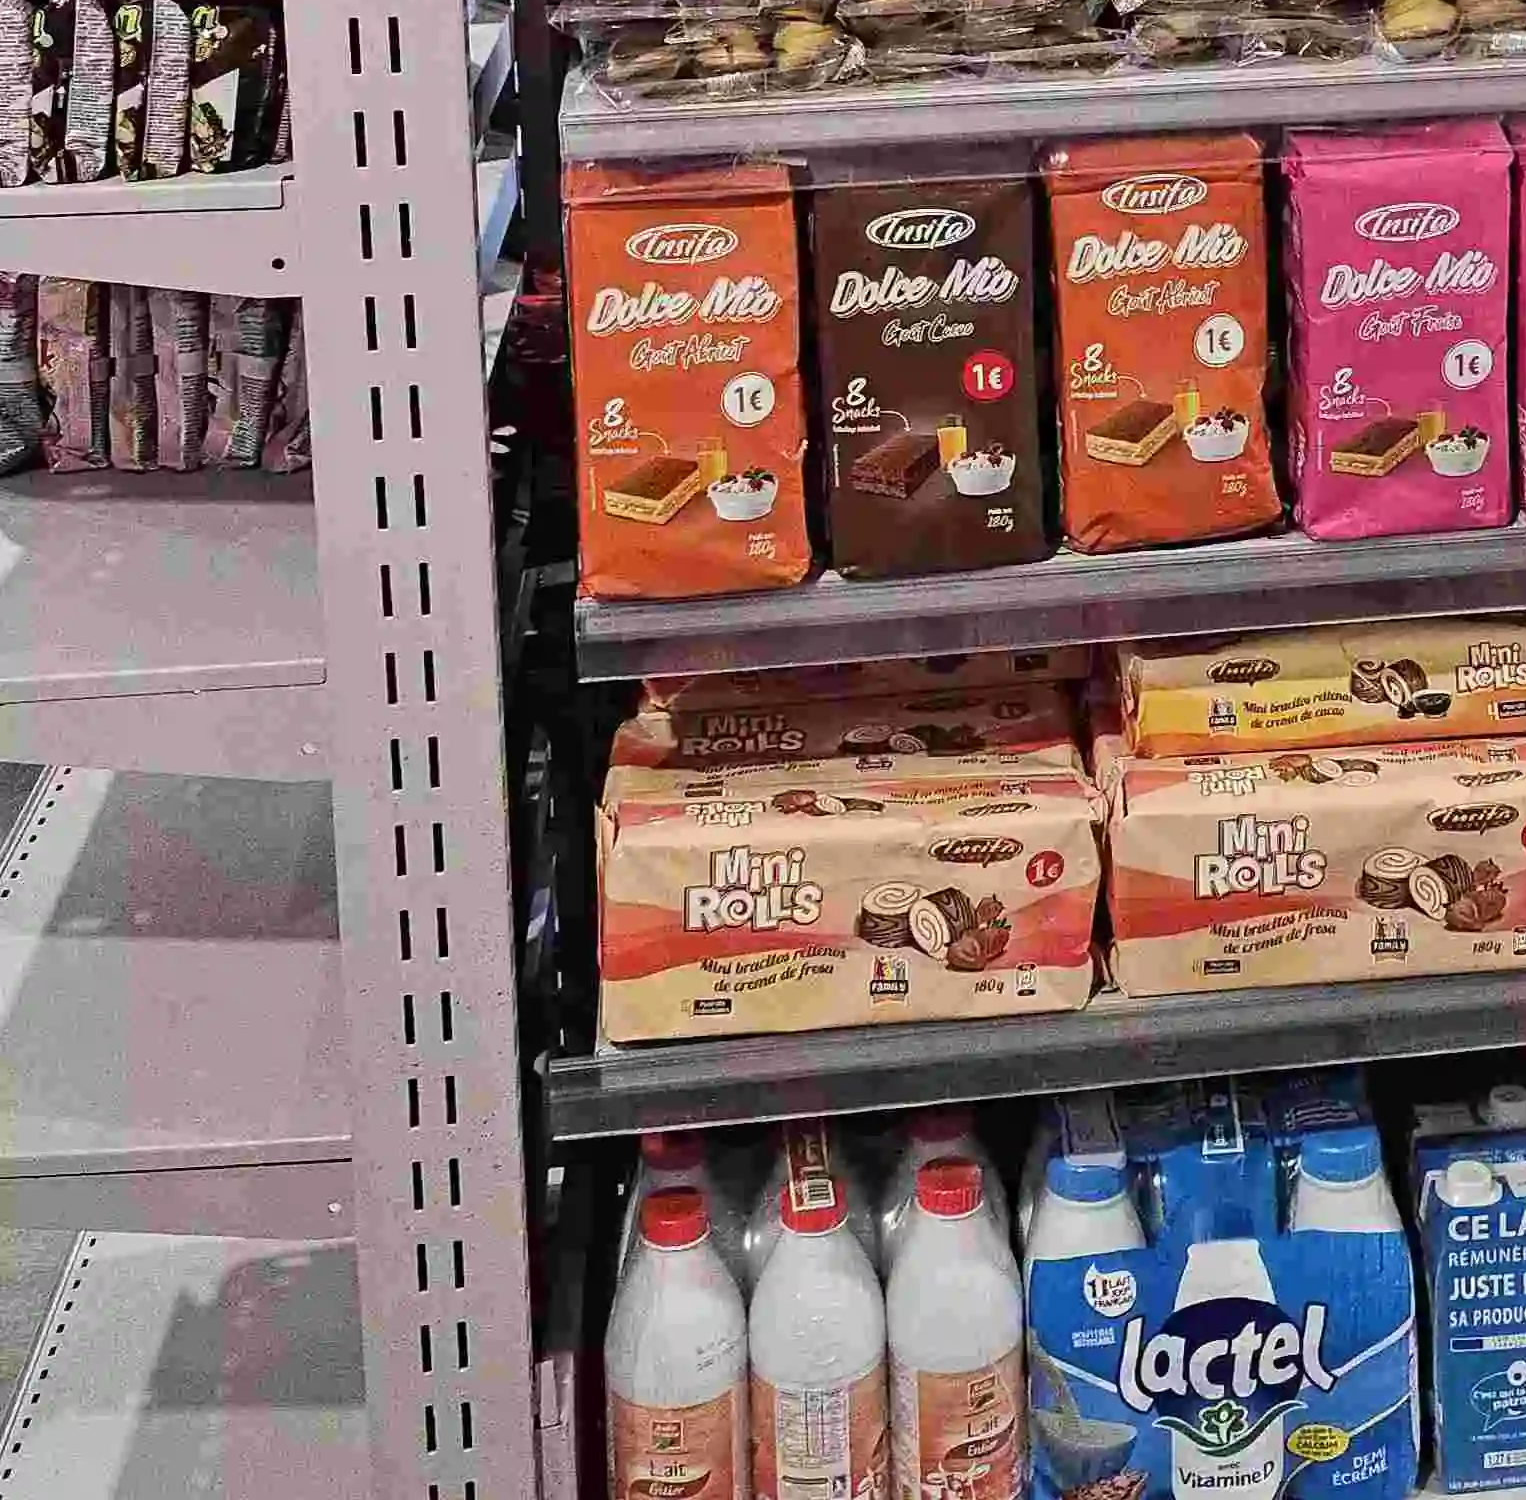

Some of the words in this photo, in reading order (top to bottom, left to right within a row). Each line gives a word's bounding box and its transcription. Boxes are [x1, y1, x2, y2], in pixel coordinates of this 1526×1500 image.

[829, 266, 940, 323] Dolce
[943, 256, 1019, 303] Mio
[1320, 258, 1425, 306] Dolce
[1425, 250, 1499, 294] Mio
[587, 280, 696, 336] Dolce
[701, 275, 783, 324] Mio
[846, 376, 867, 405] 8
[972, 364, 1004, 392] 1€
[733, 386, 764, 415] 1€
[831, 395, 882, 425] Snacks
[1468, 641, 1522, 667] Mini
[1218, 813, 1311, 858] Mini
[710, 845, 807, 889] Mini
[1194, 850, 1328, 900] ROLLS
[683, 881, 824, 934] ROLLS
[700, 956, 733, 975] Mini
[713, 978, 733, 994] de
[735, 974, 776, 993] crema
[778, 968, 797, 988] de
[798, 961, 834, 982] fresa
[1447, 1212, 1492, 1243] CE
[1449, 1272, 1517, 1302] JUSTE
[1449, 1310, 1469, 1328] SA
[1115, 1302, 1338, 1414] lactel
[650, 1461, 688, 1477] Lait
[1352, 1445, 1389, 1470] DEMI
[1178, 1465, 1261, 1491] Vitamine
